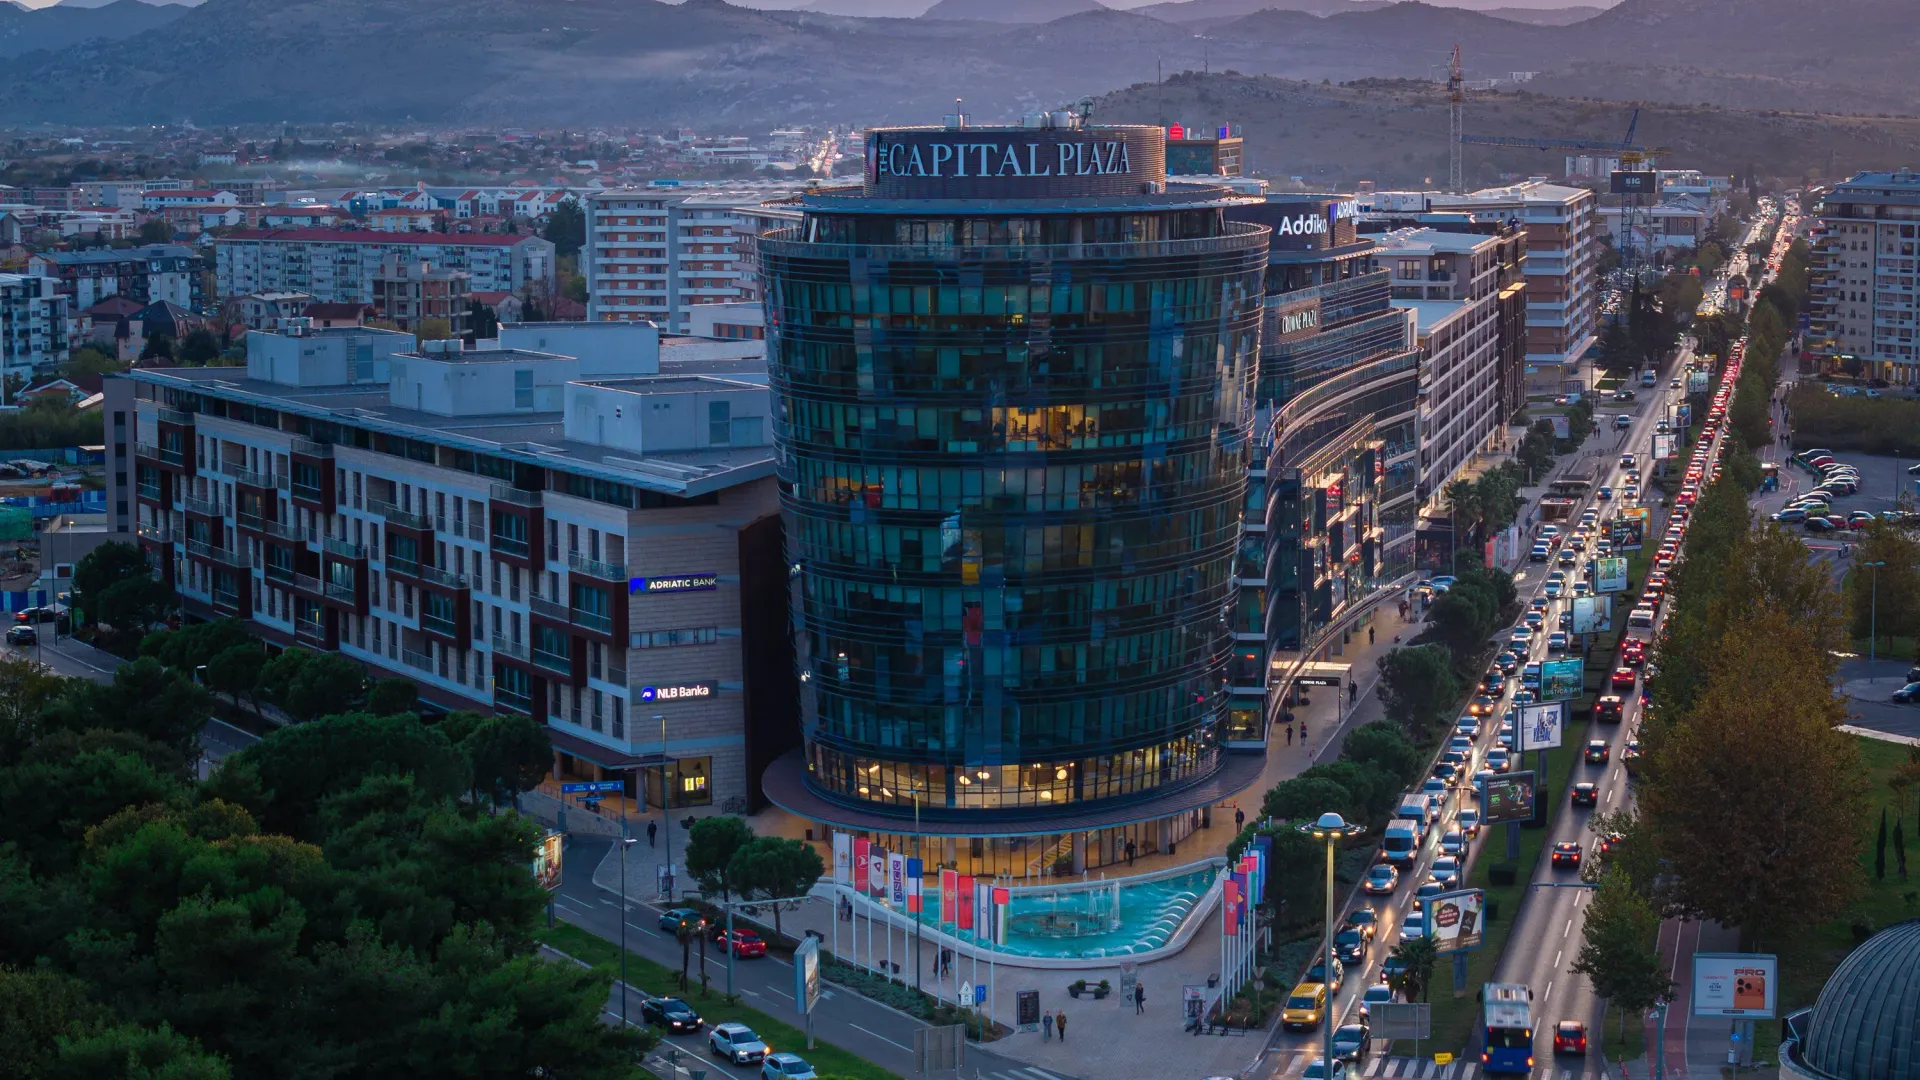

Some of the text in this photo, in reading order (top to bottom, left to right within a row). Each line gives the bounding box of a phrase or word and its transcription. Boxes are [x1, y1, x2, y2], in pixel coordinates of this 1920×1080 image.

[879, 142, 1132, 177] THE CAPITAL PLAZA
[1278, 214, 1328, 236] Addiko
[1282, 309, 1318, 334] CROWNE PLAZA
[649, 577, 717, 590] ADRIATIC BANK
[657, 685, 709, 699] NLB Banka
[1734, 968, 1766, 976] PRO
